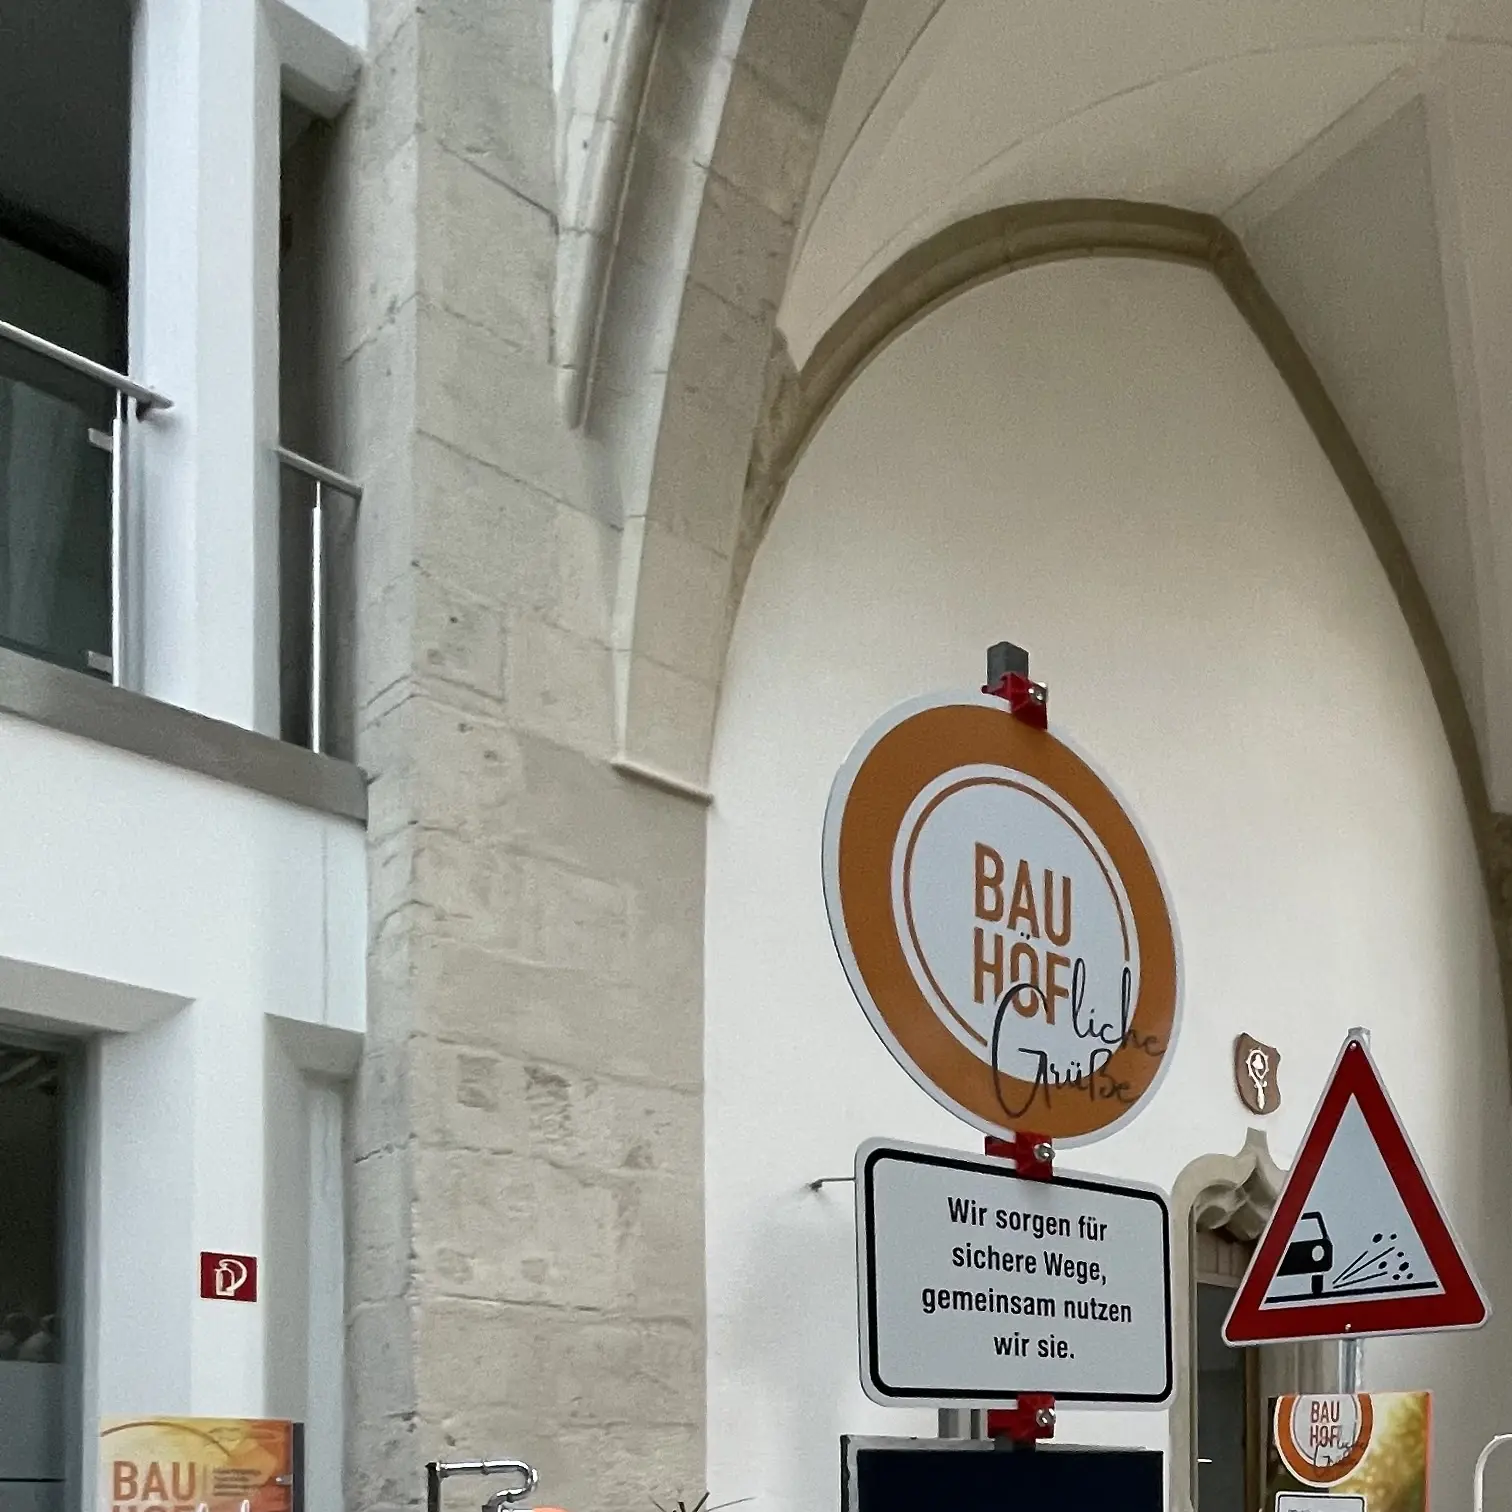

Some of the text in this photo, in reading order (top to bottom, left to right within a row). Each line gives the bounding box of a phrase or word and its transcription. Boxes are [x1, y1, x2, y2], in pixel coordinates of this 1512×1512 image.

[974, 842, 1071, 946] BAU
[948, 1197, 1107, 1241] Wir sorgen für
[952, 1243, 1106, 1285] sichere Wege,
[922, 1288, 1131, 1322] gemeinsam nutzen
[994, 1332, 1075, 1359] wir sie.
[1310, 1401, 1339, 1423] BAU
[113, 1461, 196, 1500] BAU
